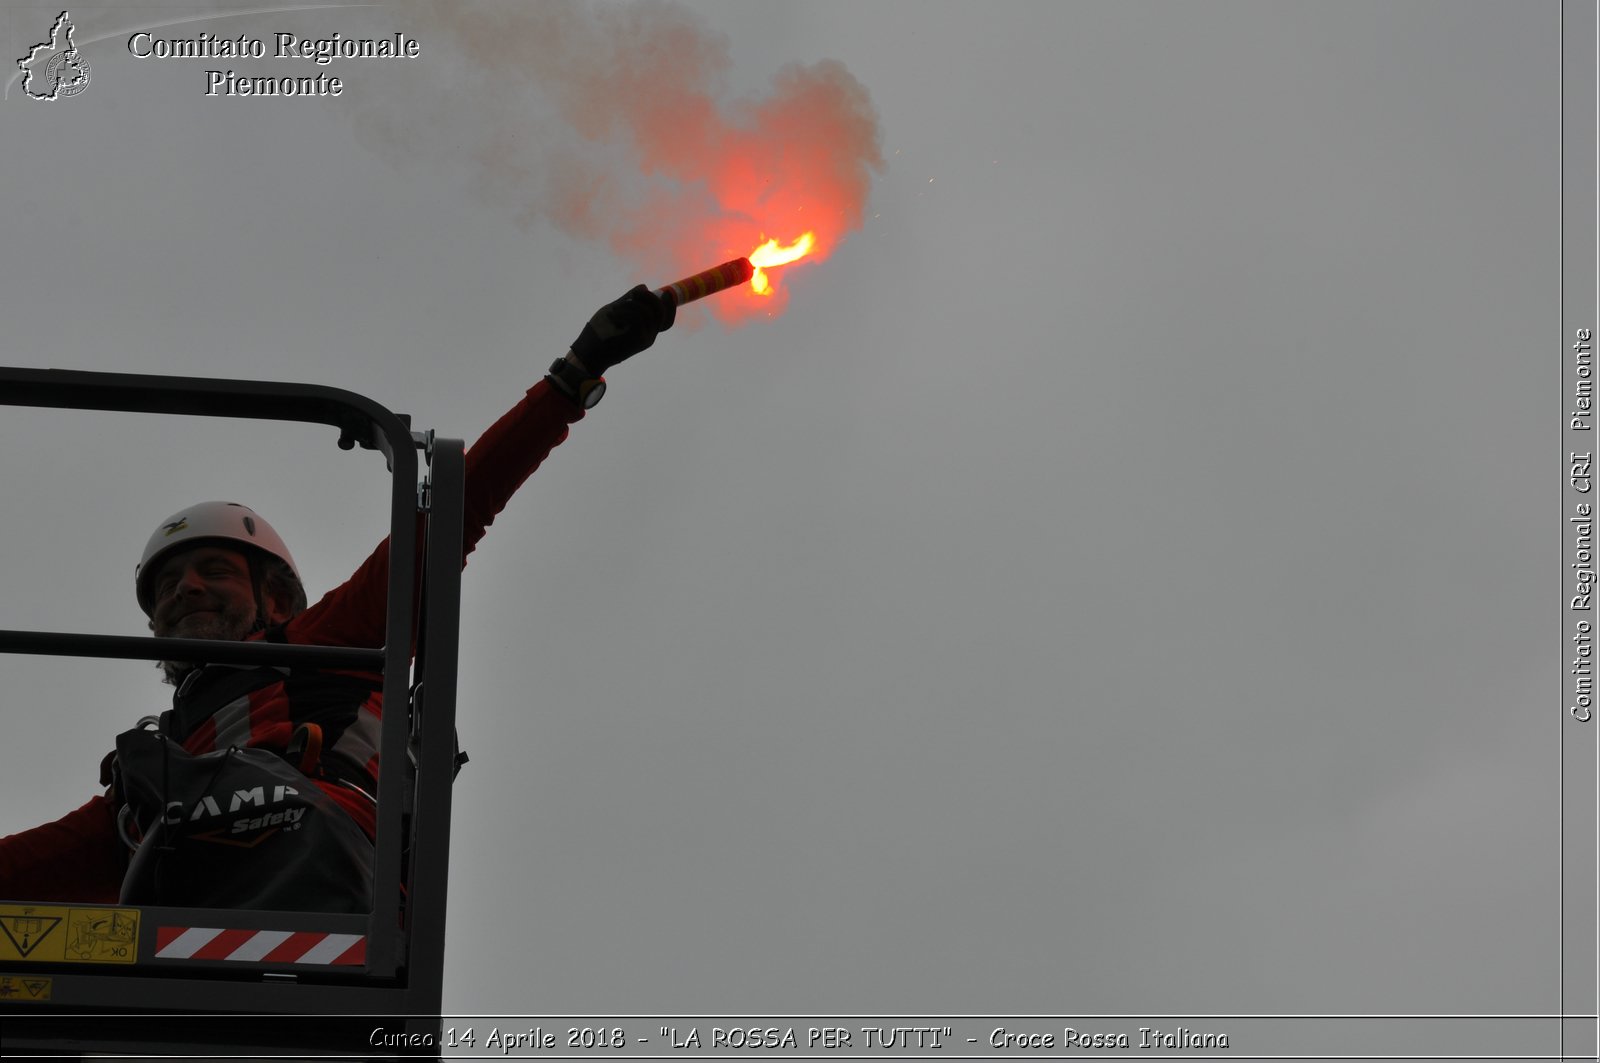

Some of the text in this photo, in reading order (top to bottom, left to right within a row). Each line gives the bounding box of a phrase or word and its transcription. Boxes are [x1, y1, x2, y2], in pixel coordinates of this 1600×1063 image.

[161, 785, 299, 825] CAMP
[231, 807, 306, 834] Safety
[111, 946, 128, 957] OK
